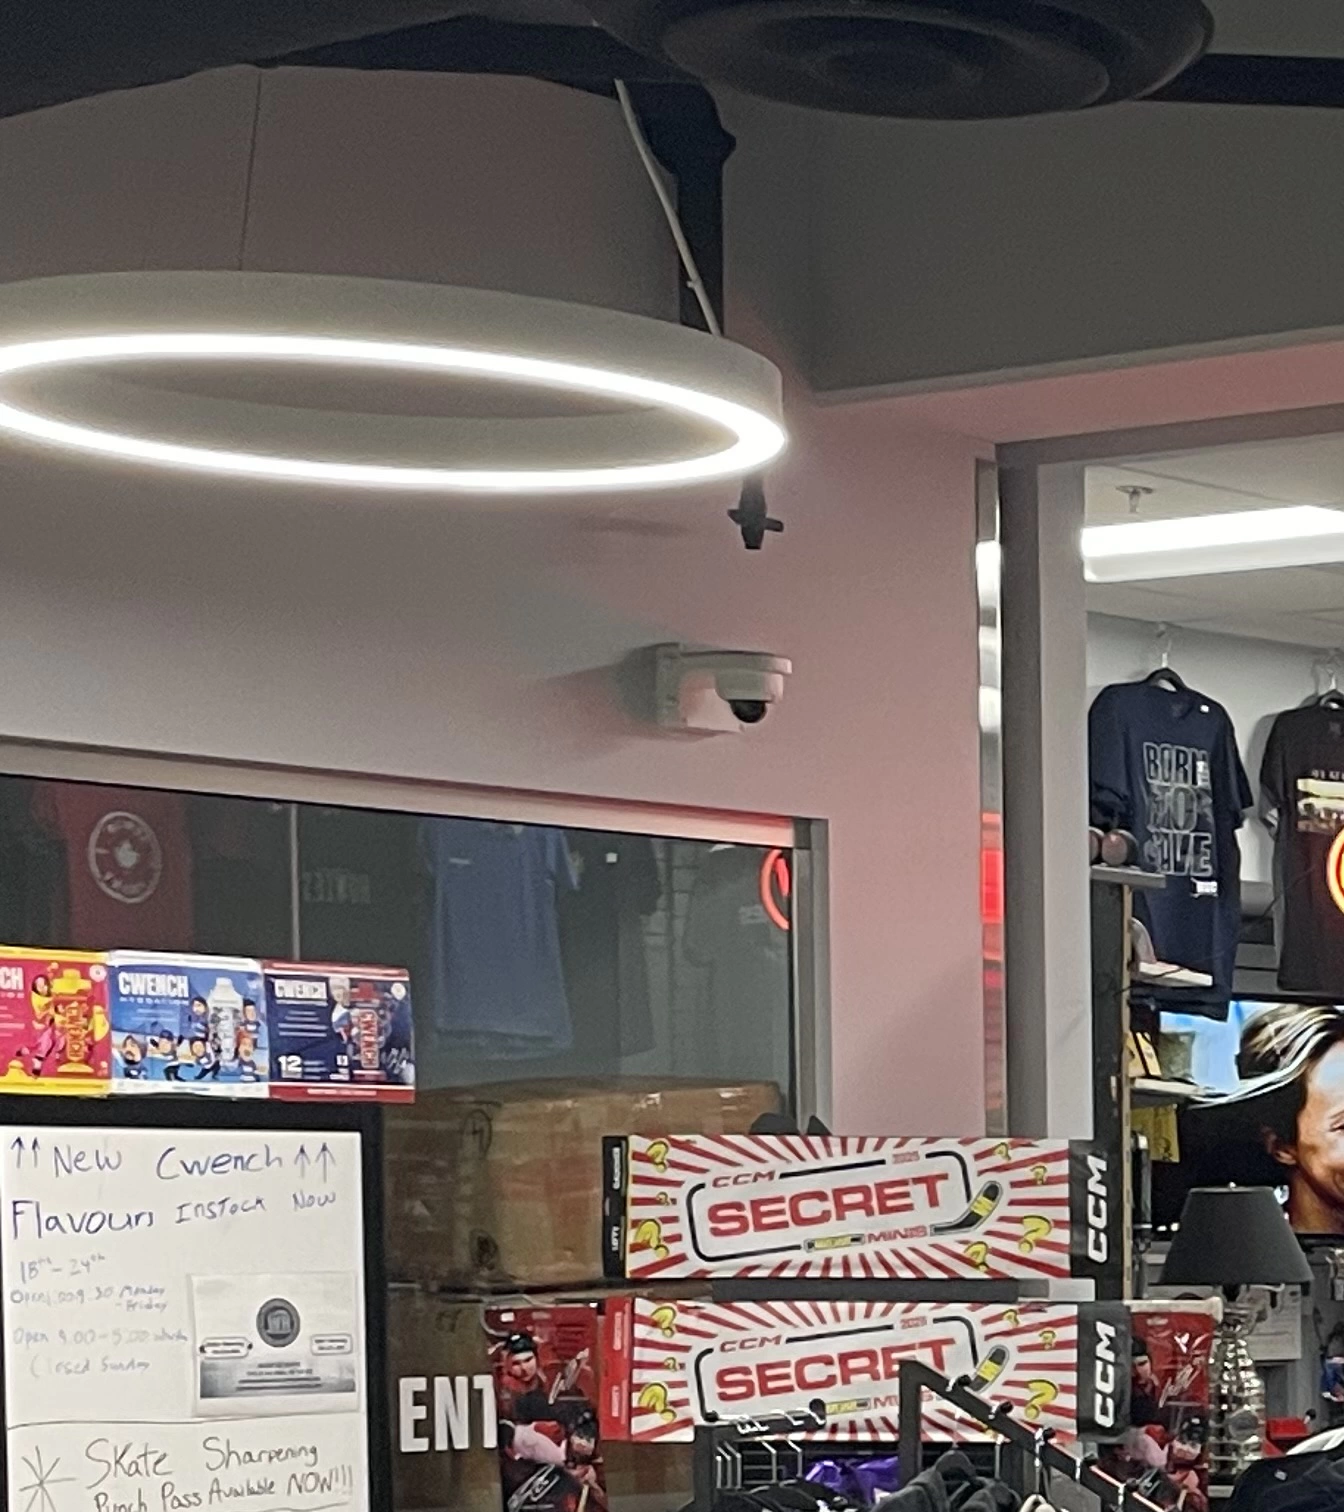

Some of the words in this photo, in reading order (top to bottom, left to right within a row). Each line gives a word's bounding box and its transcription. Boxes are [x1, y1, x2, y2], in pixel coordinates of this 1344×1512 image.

[118, 971, 189, 997] CWENCH
[53, 1144, 123, 1178] New
[156, 1143, 283, 1181] Cwench
[711, 1168, 776, 1191] CCM
[706, 1172, 950, 1239] SECRET
[1085, 1154, 1110, 1265] CCM
[718, 1333, 783, 1354] CCM
[714, 1337, 957, 1403] SECRET
[1093, 1320, 1117, 1429] CCM
